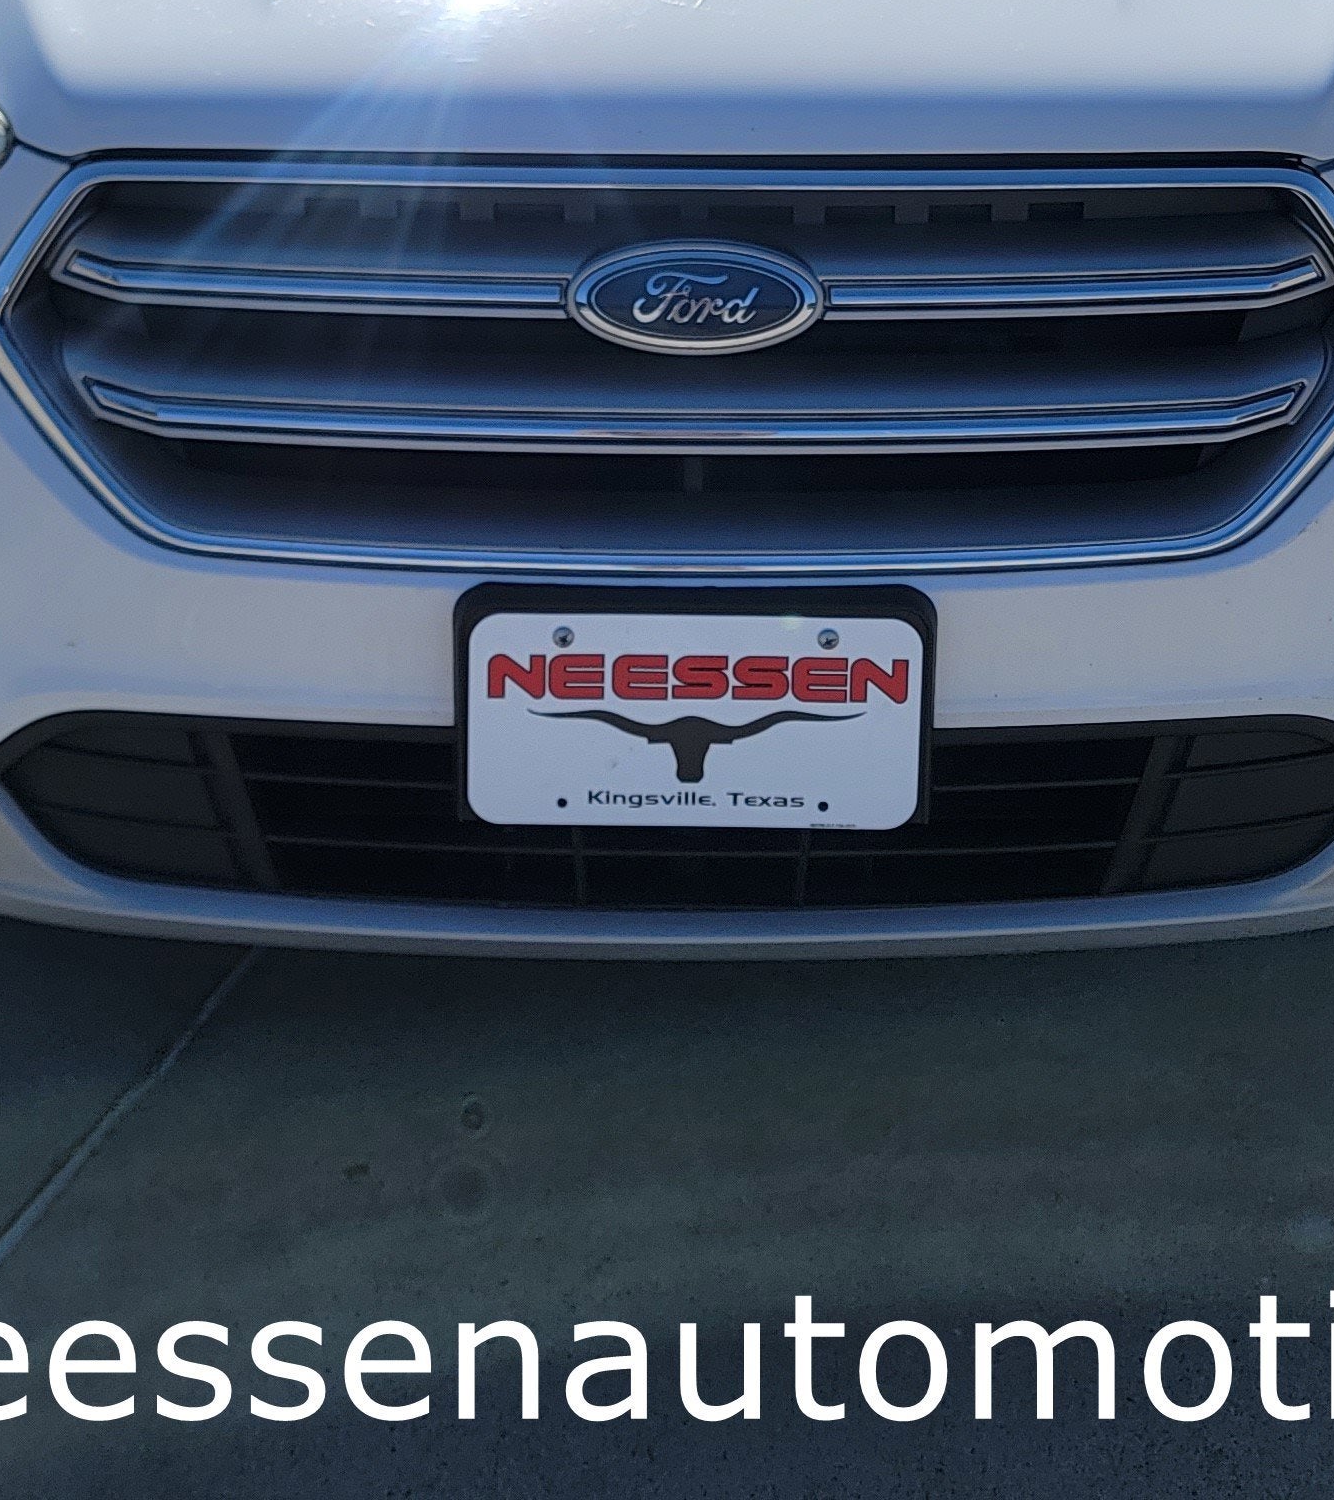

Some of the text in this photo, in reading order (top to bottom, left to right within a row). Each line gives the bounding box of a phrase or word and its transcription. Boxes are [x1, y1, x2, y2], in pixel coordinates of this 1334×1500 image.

[632, 271, 761, 324] Ford
[487, 653, 910, 705] NEESSEN
[726, 791, 806, 809] Texas
